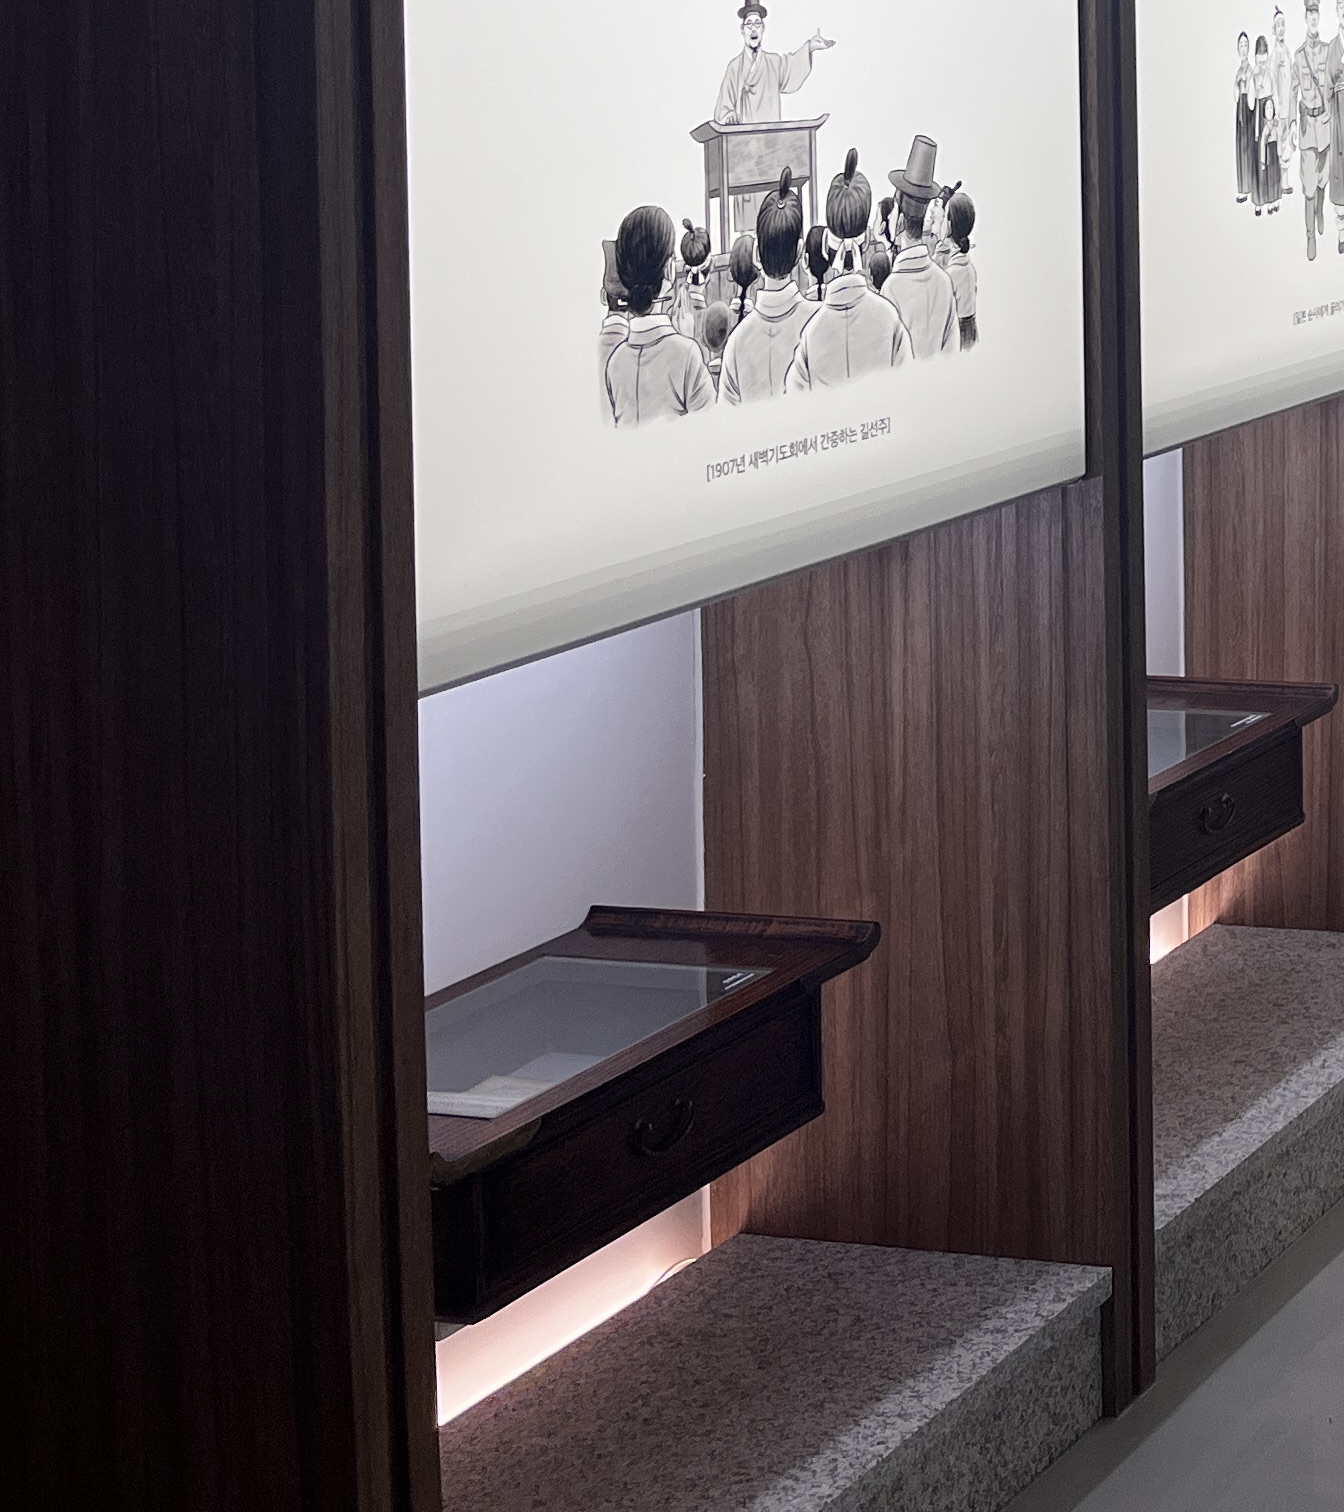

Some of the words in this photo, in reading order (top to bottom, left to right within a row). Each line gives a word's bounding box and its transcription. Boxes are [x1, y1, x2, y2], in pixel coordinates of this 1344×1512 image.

[706, 454, 746, 482] [1907년
[749, 435, 818, 470] 새벽기도회에서
[820, 427, 858, 451] 간증하는
[859, 417, 891, 440] 길선주]
